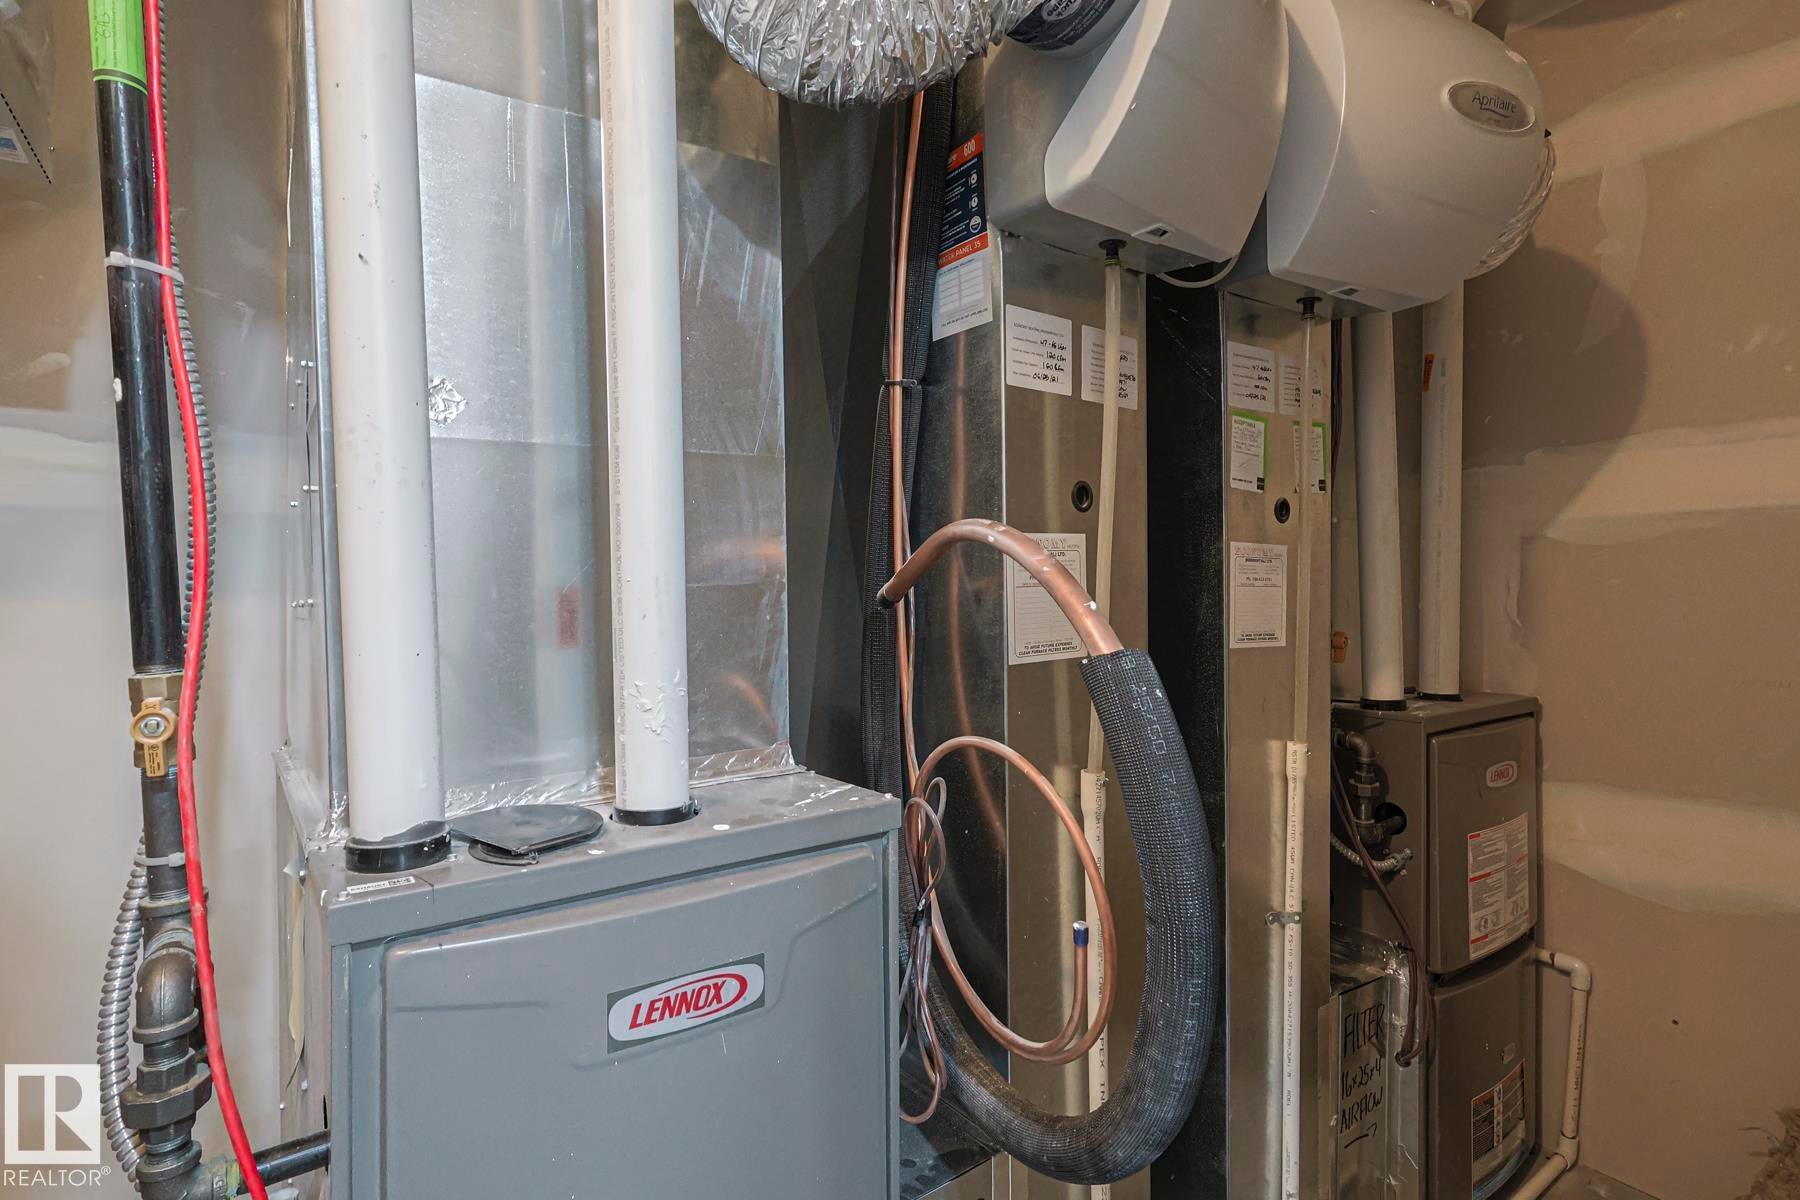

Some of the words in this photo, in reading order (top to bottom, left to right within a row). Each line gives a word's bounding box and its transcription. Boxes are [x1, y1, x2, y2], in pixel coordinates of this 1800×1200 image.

[1471, 90, 1517, 113] Aprilaire
[606, 142, 614, 187] CONTROL
[963, 139, 976, 157] 600
[955, 244, 972, 257] PANEL
[613, 461, 621, 496] SYSTEM
[614, 555, 623, 595] CONTROL
[629, 979, 727, 1030] LENNOX
[1343, 1002, 1385, 1058] FILTER
[1341, 1058, 1382, 1100] 16x25x4
